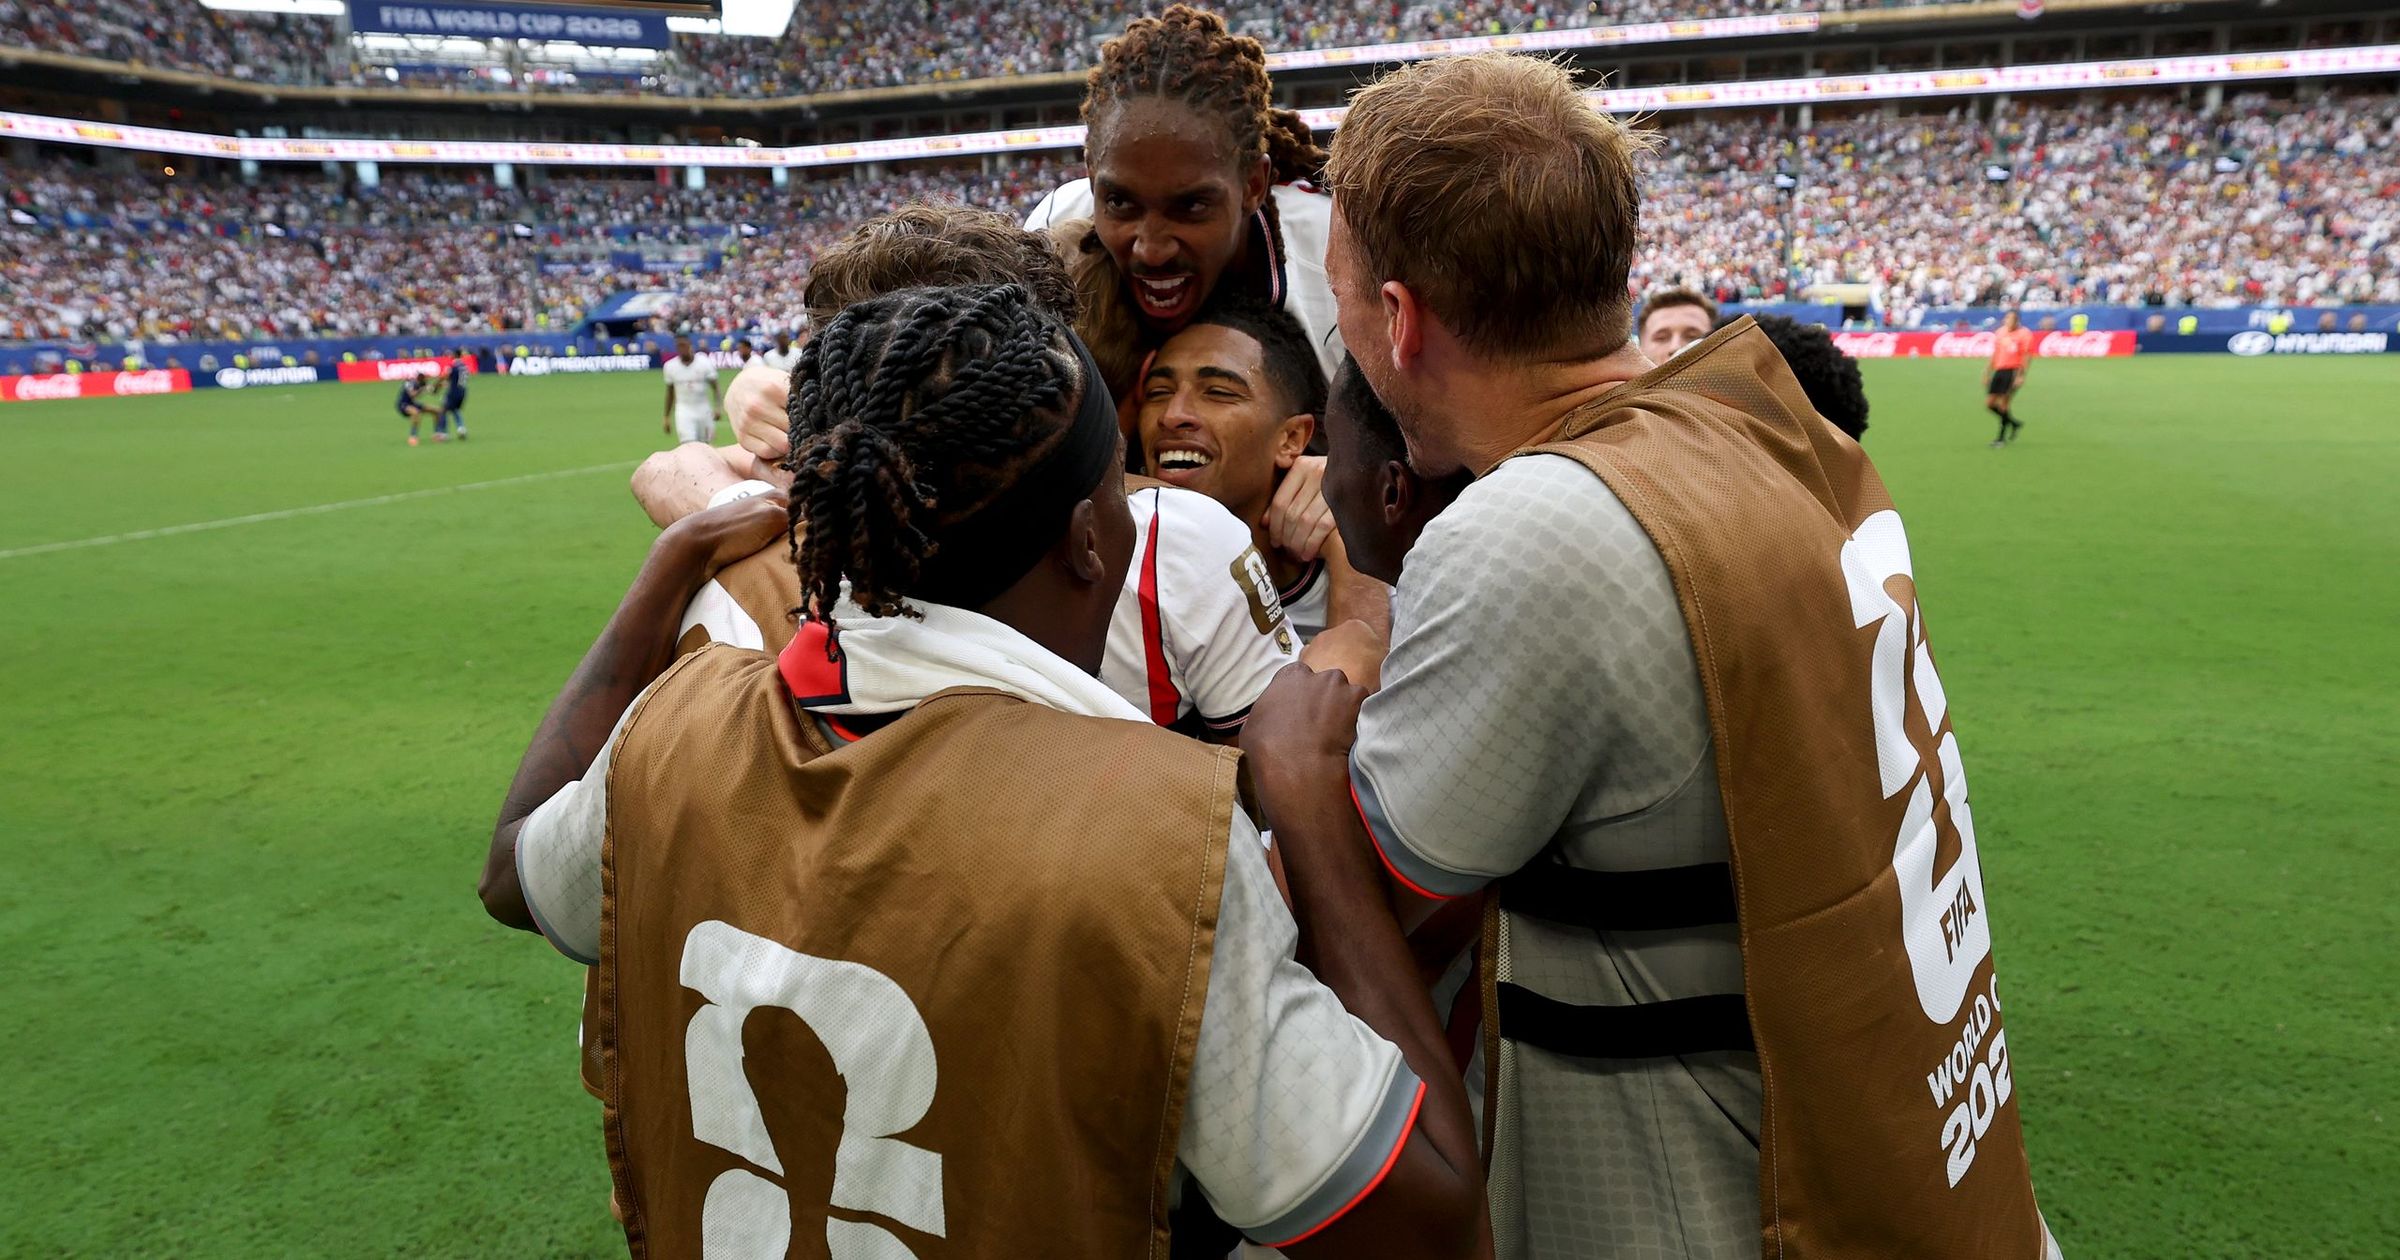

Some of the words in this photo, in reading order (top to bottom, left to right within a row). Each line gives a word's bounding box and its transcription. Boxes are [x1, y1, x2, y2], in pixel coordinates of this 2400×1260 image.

[380, 6, 434, 29] FIFA
[432, 9, 517, 33] WORLD
[518, 12, 563, 35] CUP
[565, 15, 642, 39] 2026
[2039, 331, 2112, 356] Coca-Cola
[2274, 333, 2388, 353] HYUNDAI
[246, 366, 318, 385] HYUNDAI
[509, 356, 550, 376] ADI
[1939, 875, 1976, 965] FIFA
[1926, 993, 1991, 1109] WORLD
[1940, 1027, 2012, 1189] 202
